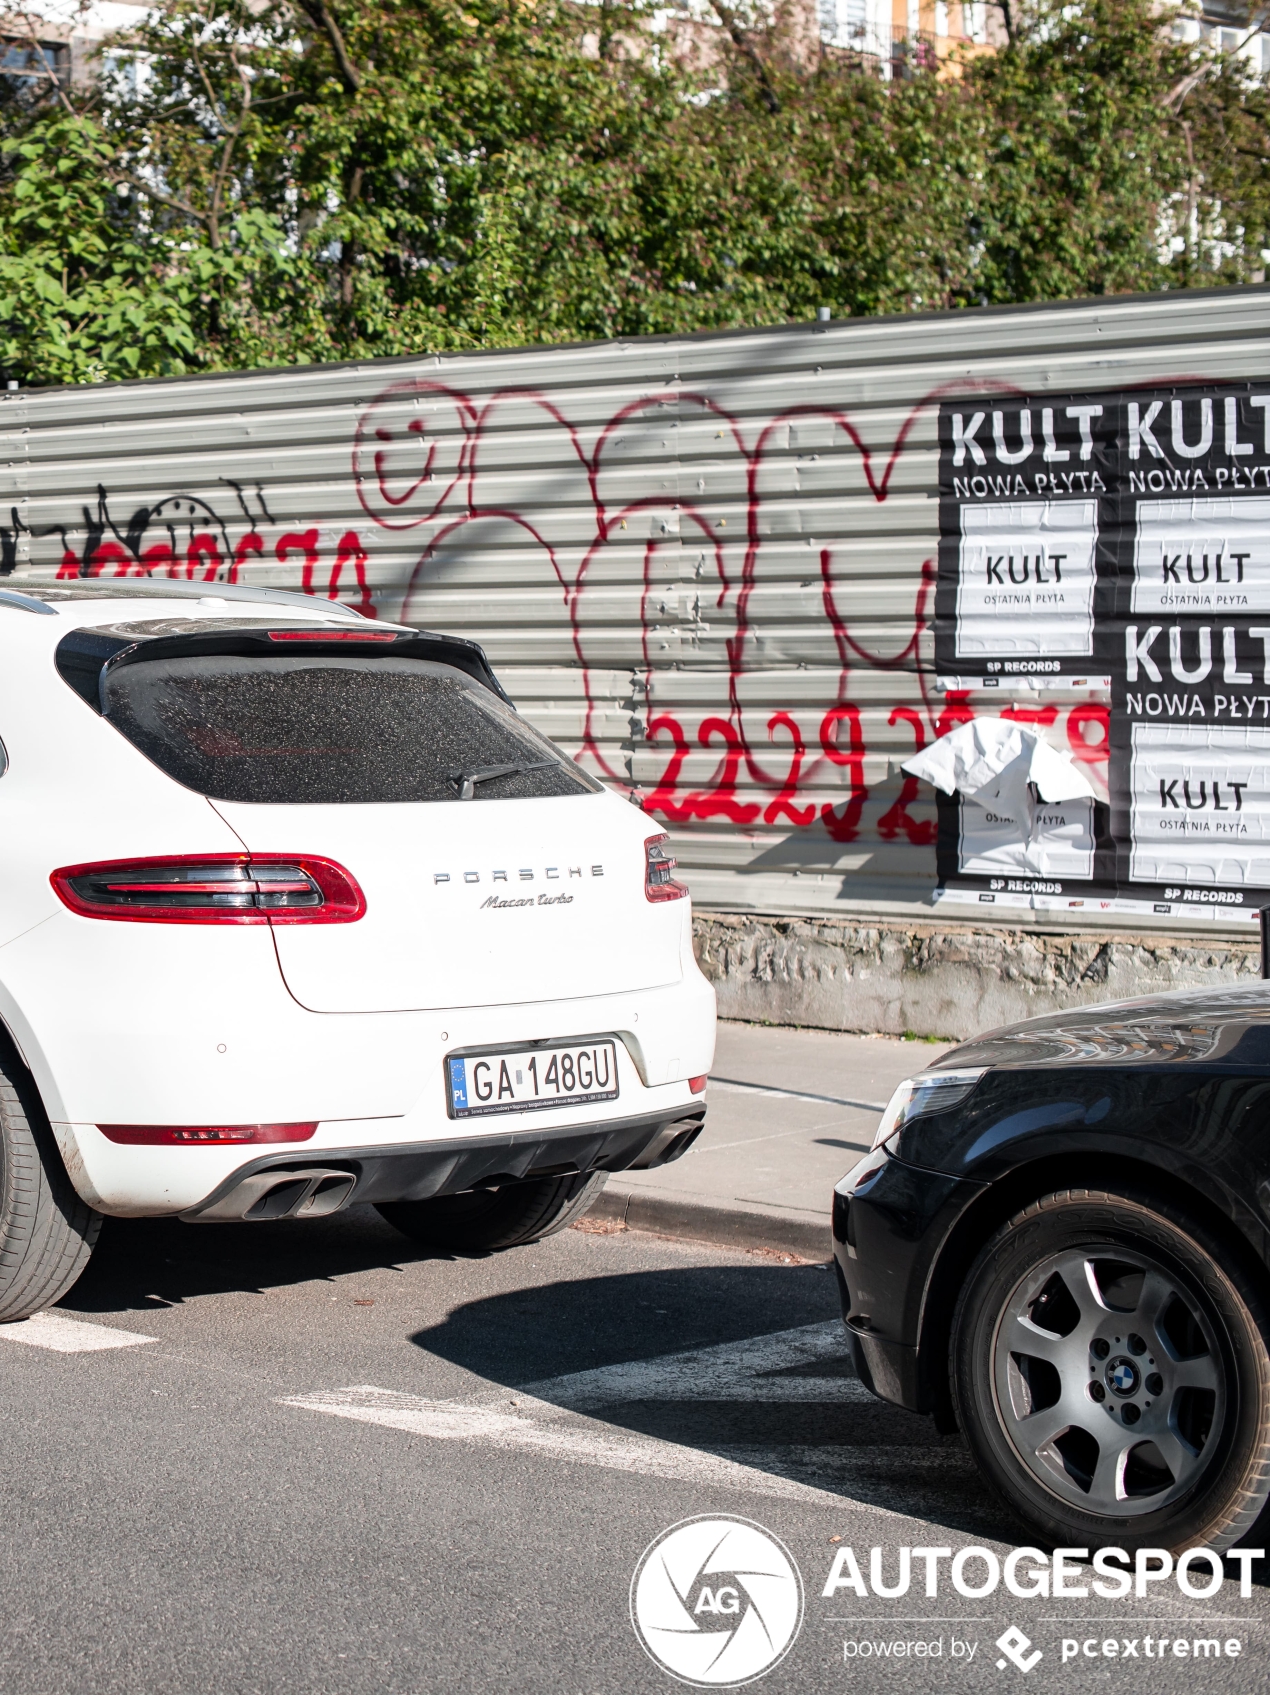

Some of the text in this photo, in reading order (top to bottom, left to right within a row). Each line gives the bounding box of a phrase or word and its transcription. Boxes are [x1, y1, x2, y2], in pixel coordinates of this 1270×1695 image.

[952, 404, 1103, 467] KULT
[952, 471, 1107, 498] NOWA PŁYTA
[1130, 469, 1209, 493] NOWA
[986, 554, 1068, 585] KULT
[1163, 553, 1251, 584] KULT
[983, 593, 1065, 604] OSTATNIA PŁYTA
[1160, 595, 1248, 606] OSTATNIA PŁYTA
[987, 661, 1061, 673] SP RECORDS
[1126, 692, 1206, 717] NOWA
[1159, 779, 1248, 811] KULT
[1036, 815, 1066, 826] PŁYTA
[1159, 820, 1248, 834] OSTATNIA PŁYTA
[433, 865, 605, 885] PORSCHE
[990, 879, 1063, 894] SP RECORDS
[479, 895, 535, 909] Macan
[1164, 888, 1244, 904] SP RECORDS
[473, 1048, 611, 1102] GA 148GU
[454, 1089, 467, 1101] PL
